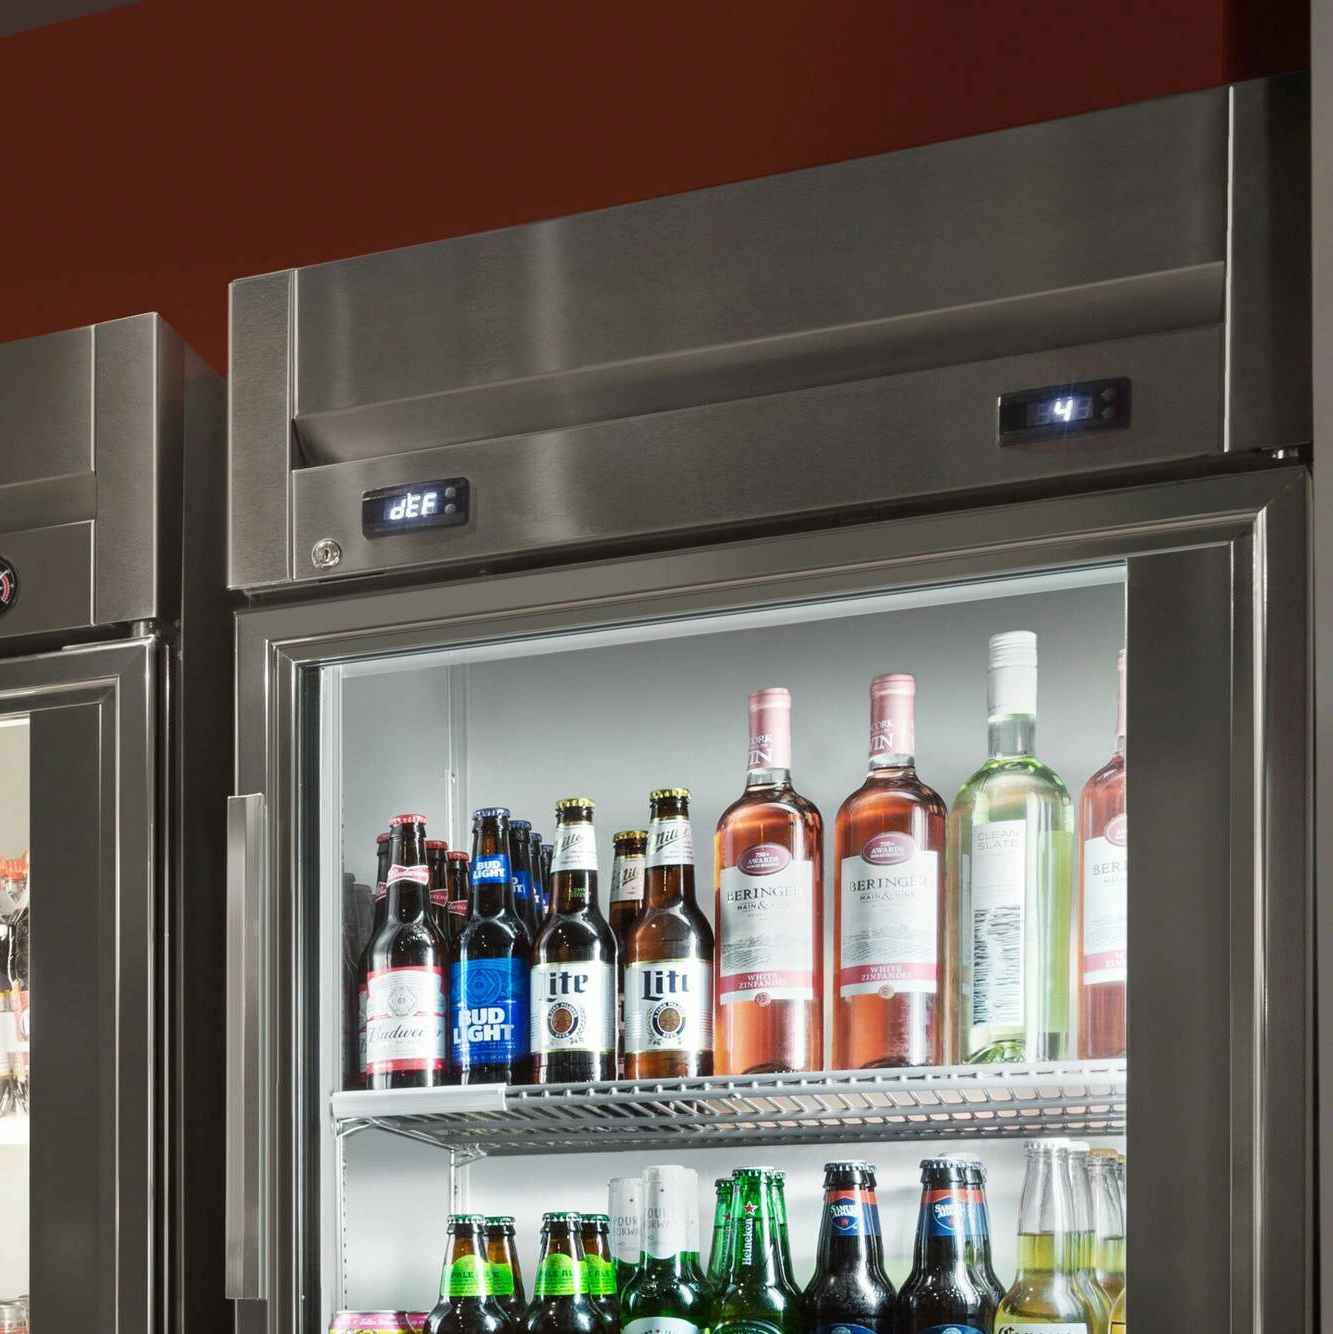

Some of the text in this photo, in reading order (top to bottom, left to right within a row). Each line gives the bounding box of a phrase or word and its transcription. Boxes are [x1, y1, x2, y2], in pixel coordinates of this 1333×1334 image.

[871, 846, 904, 856] AWARDS
[477, 860, 501, 870] BUD
[748, 857, 780, 865] AWARDS
[473, 868, 505, 879] LIGHT
[458, 1006, 506, 1025] BUD
[453, 1023, 515, 1045] LIGHT
[742, 1217, 754, 1266] Heineken
